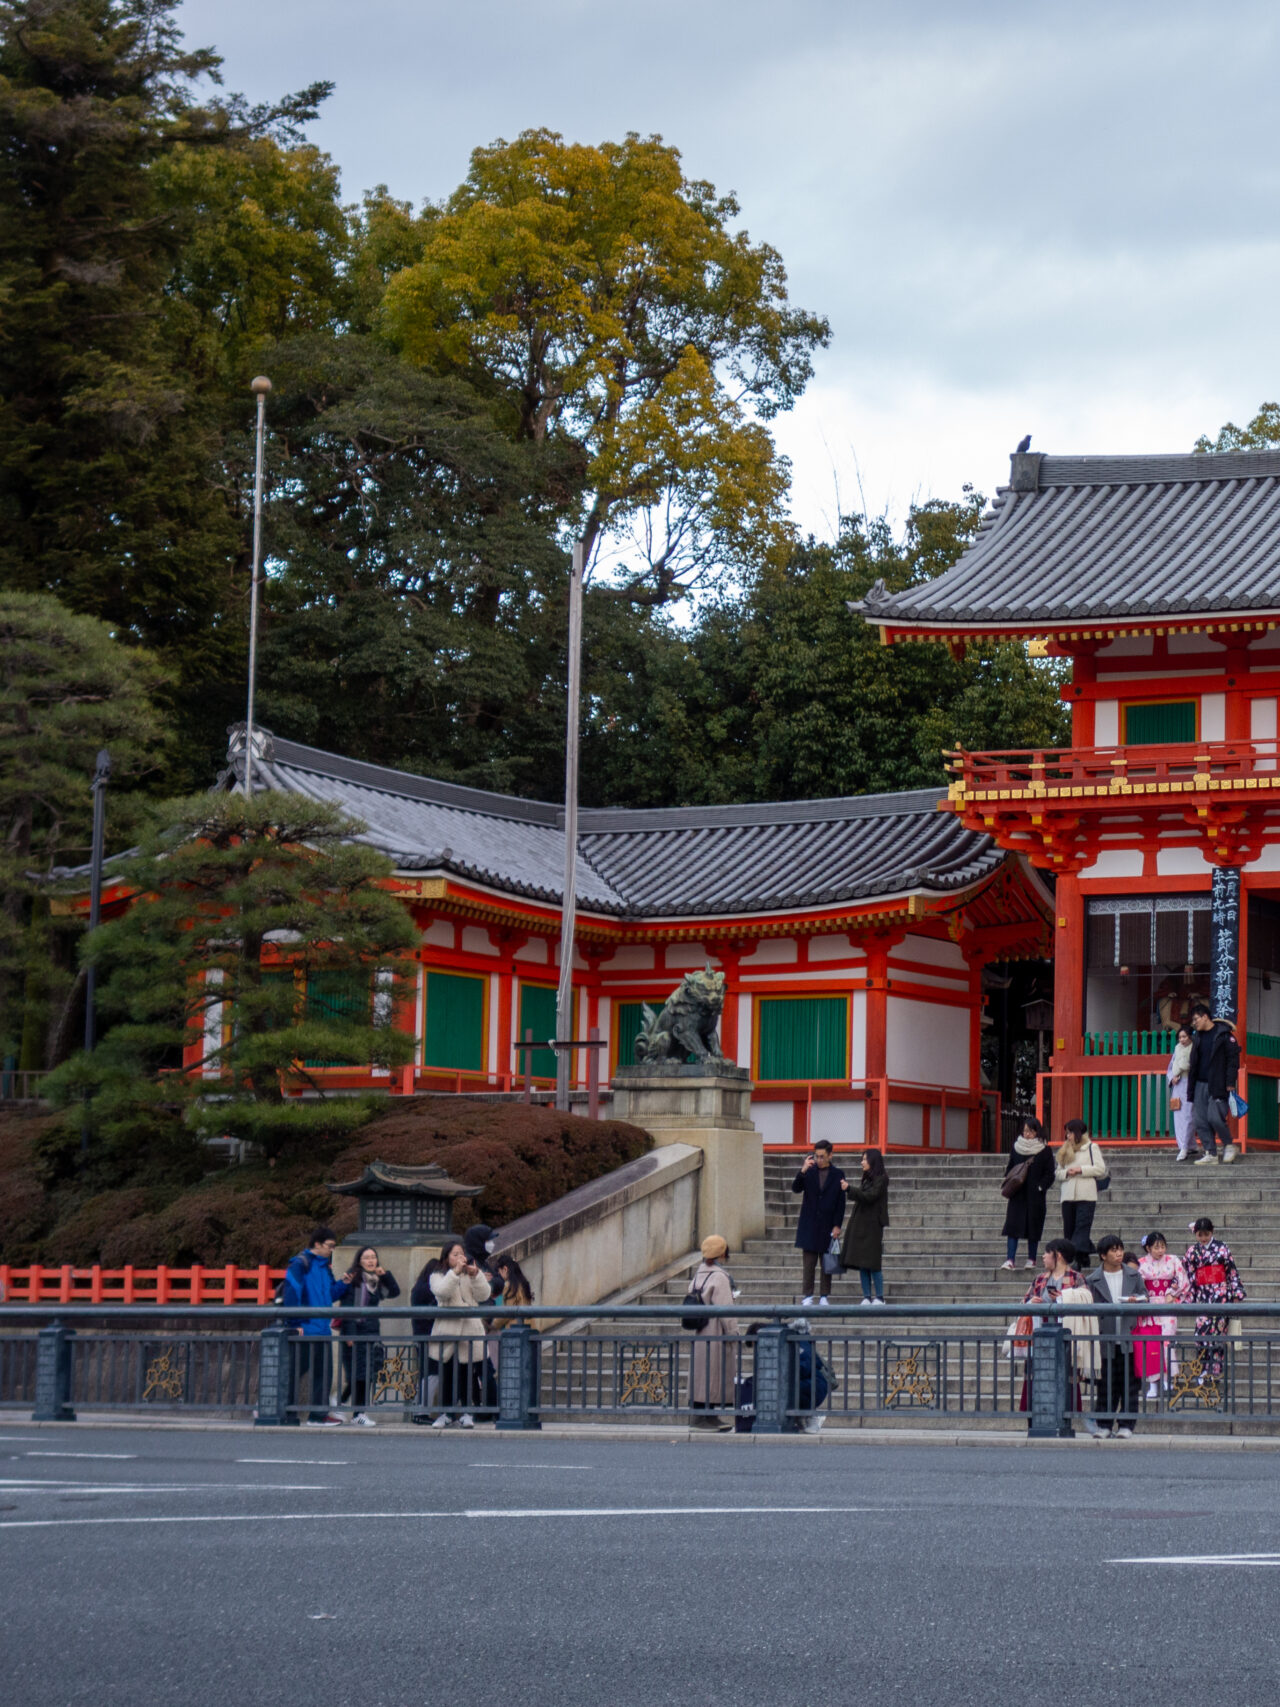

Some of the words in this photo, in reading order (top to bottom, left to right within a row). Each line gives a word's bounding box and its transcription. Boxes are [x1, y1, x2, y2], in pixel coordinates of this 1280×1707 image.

[1212, 868, 1226, 926] 午前九時
[1225, 870, 1239, 920] 二月二日
[1213, 928, 1235, 1019] 節分祈願祭
